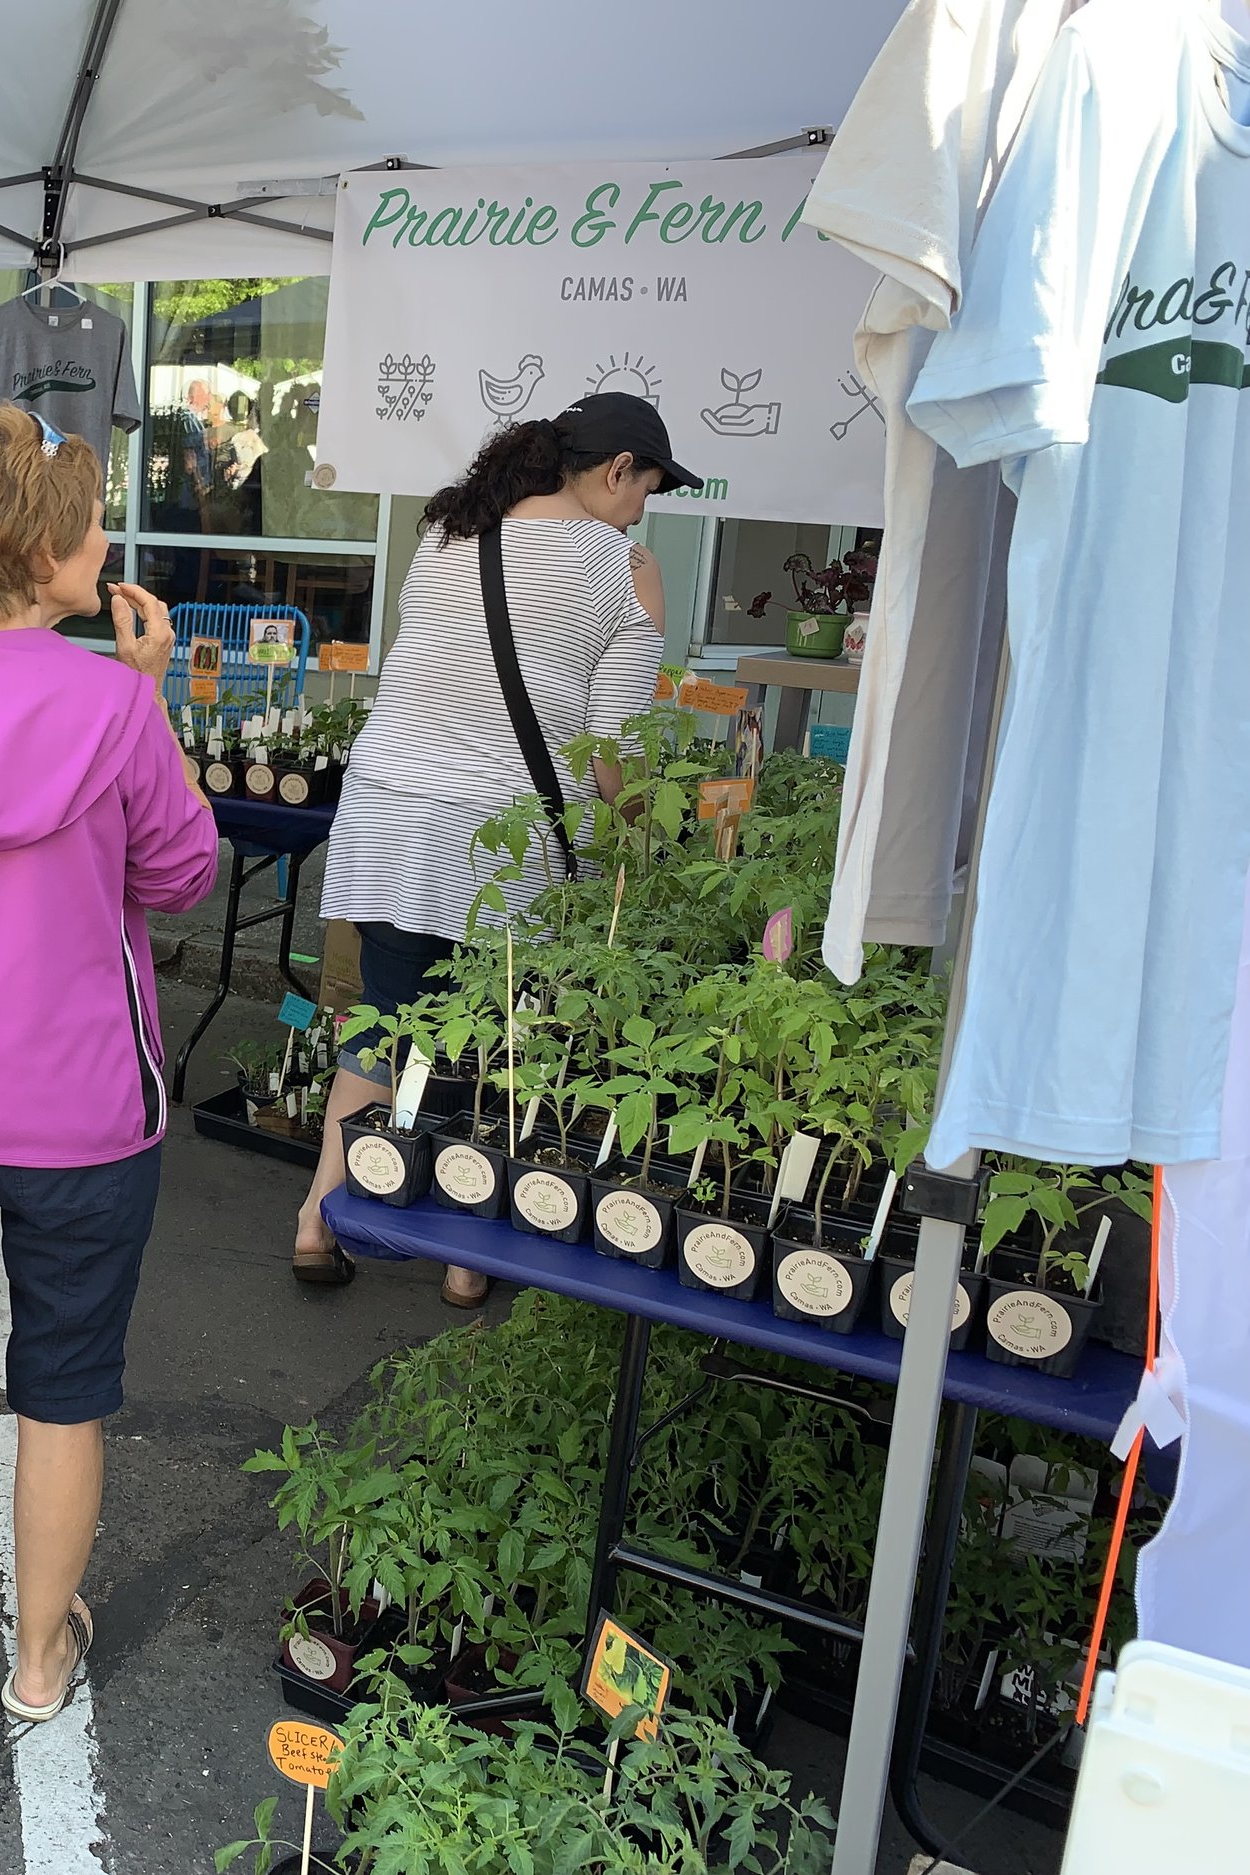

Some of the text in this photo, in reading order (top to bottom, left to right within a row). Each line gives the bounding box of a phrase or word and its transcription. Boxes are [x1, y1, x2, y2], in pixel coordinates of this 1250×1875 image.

[363, 188, 558, 248] Prairie
[570, 183, 620, 248] &
[625, 181, 766, 245] Fern
[560, 277, 687, 302] CAMAS WA
[354, 1142, 399, 1173] PrairieAndFern.com
[440, 1153, 487, 1185] PrairieAndFern.com
[362, 1175, 396, 1189] Camas WA
[445, 1184, 466, 1200] Camas
[520, 1178, 569, 1213] PrairieAndFern.com
[525, 1207, 562, 1226] Camas WA
[602, 1197, 651, 1239] PrairieAndFern.com
[600, 1222, 636, 1248] Camas WA
[691, 1231, 746, 1267] PrairieAndFern.com
[695, 1262, 737, 1282] Camas WA
[785, 1258, 843, 1297] PrairieAndFern.com
[789, 1290, 833, 1312] Camas WA
[992, 1299, 1058, 1338] PrairieAndFern.com
[997, 1333, 1046, 1353] Camas WA
[282, 1743, 308, 1760] Beef
[276, 1757, 333, 1776] Tomatoe
